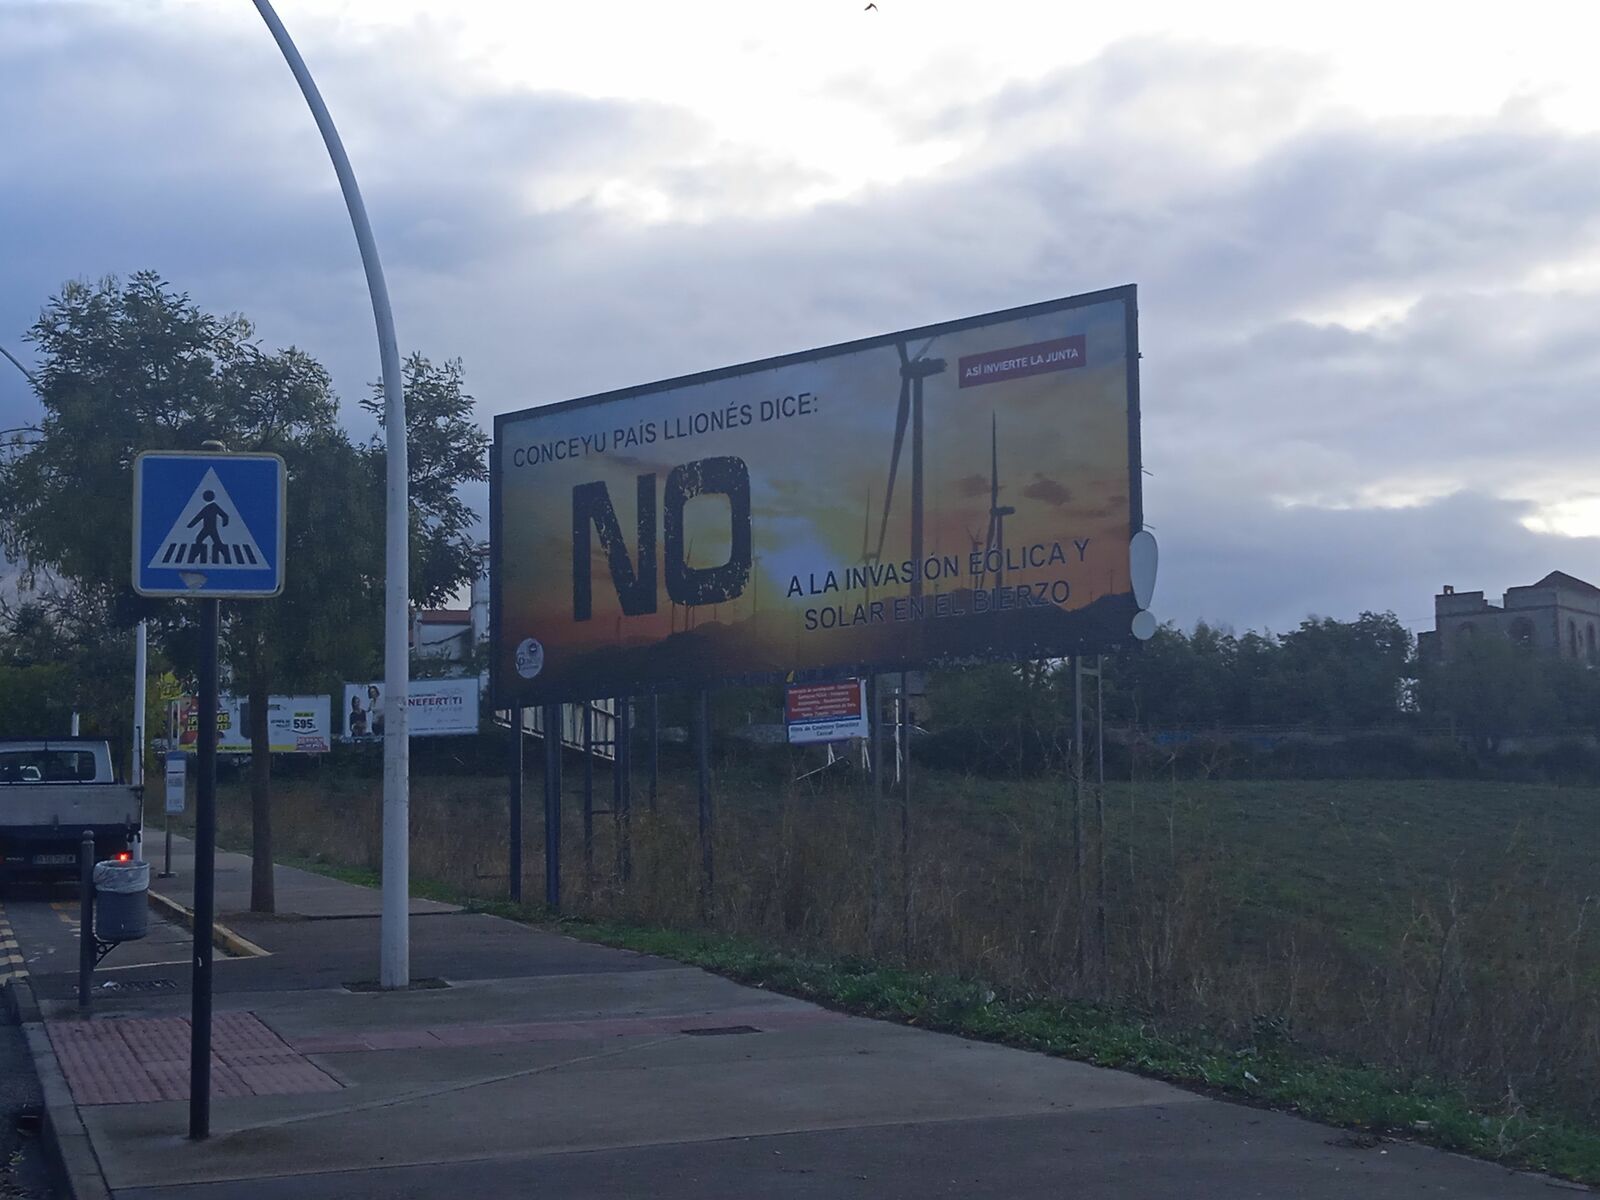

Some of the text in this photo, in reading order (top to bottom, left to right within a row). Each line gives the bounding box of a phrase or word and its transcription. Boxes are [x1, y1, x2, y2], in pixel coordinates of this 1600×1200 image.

[965, 347, 1080, 378] ASÍ INVIERTE LA JUNTA
[513, 392, 819, 468] CONCEYU PAÍS LLIONÉS DICE:
[572, 455, 753, 622] NO
[786, 538, 1091, 599] A LA INVASIÓN EÓLICA Y
[804, 579, 1071, 631] SOLAR EN EL BIERZO
